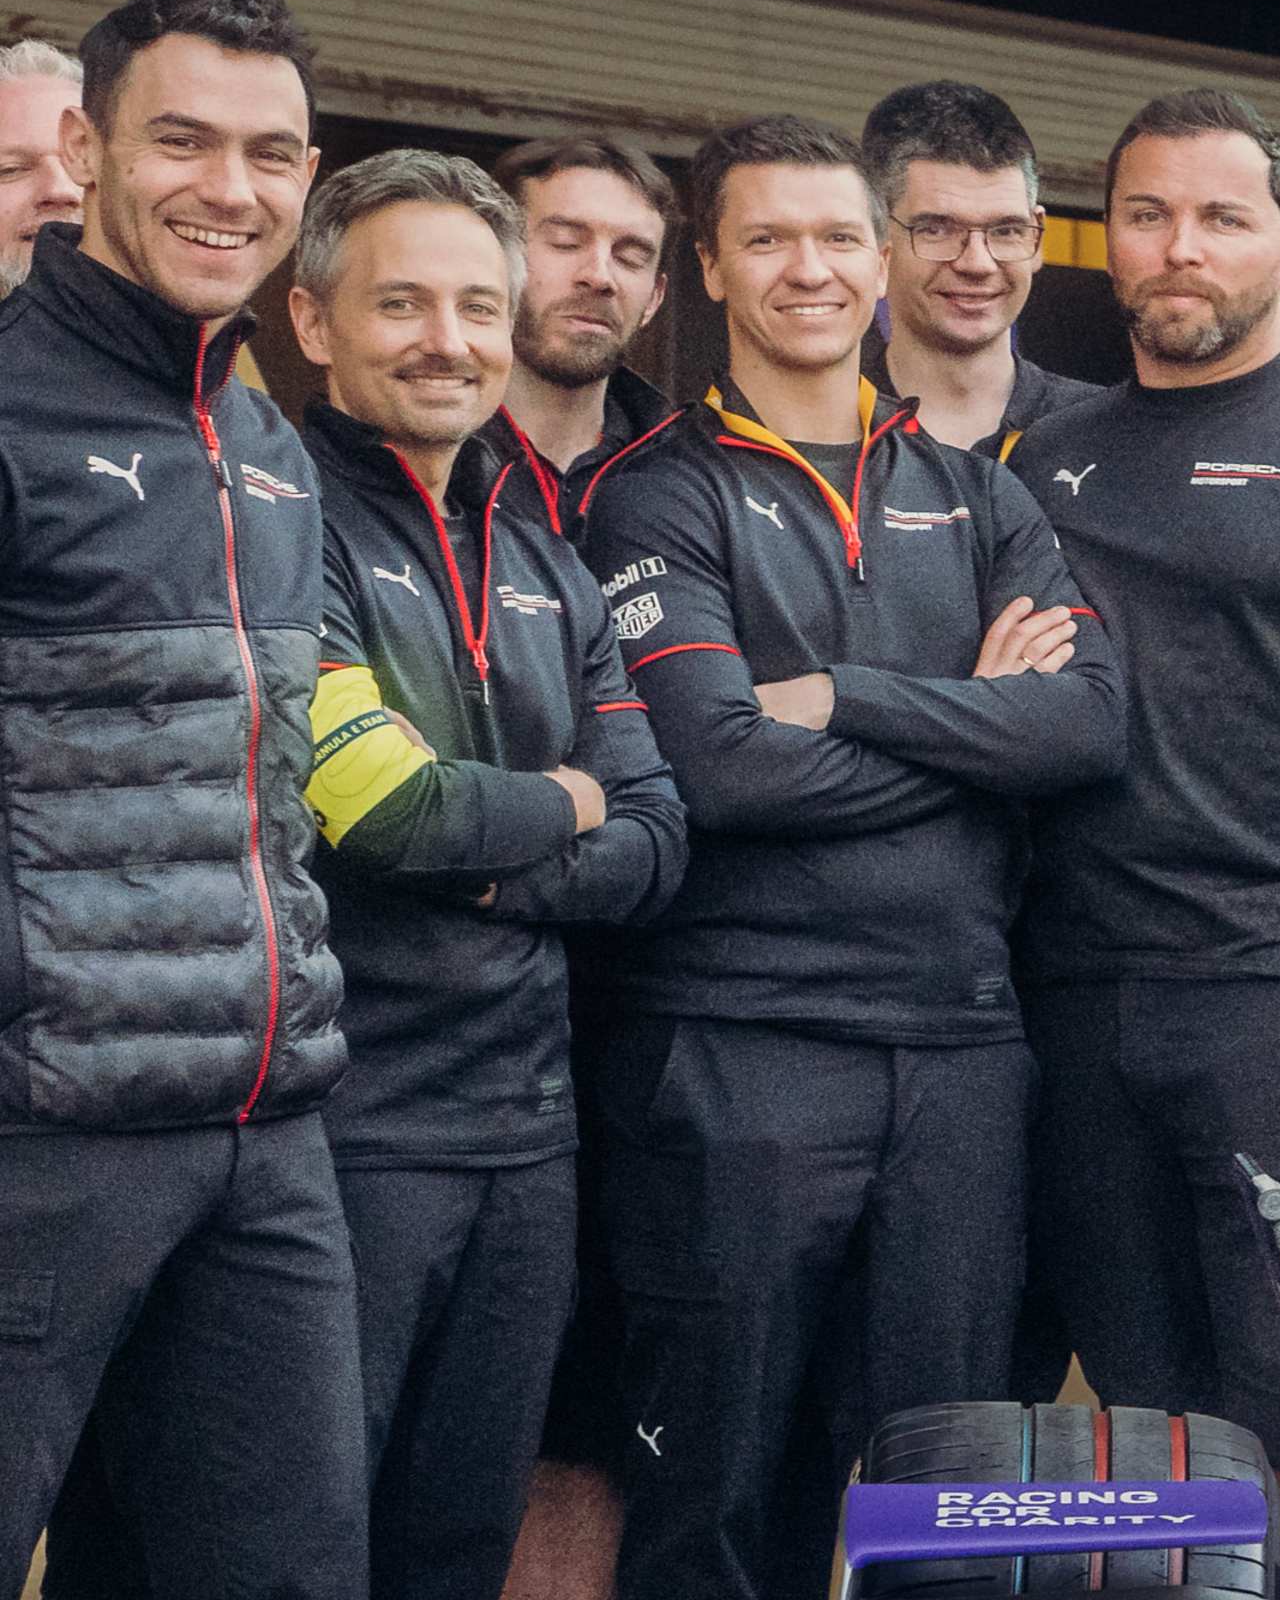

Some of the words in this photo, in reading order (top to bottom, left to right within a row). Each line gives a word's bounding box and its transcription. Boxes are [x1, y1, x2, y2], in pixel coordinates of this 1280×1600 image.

[936, 1490, 1159, 1506] RACING
[936, 1505, 1052, 1518] FOR
[934, 1514, 1198, 1528] CHARITY
